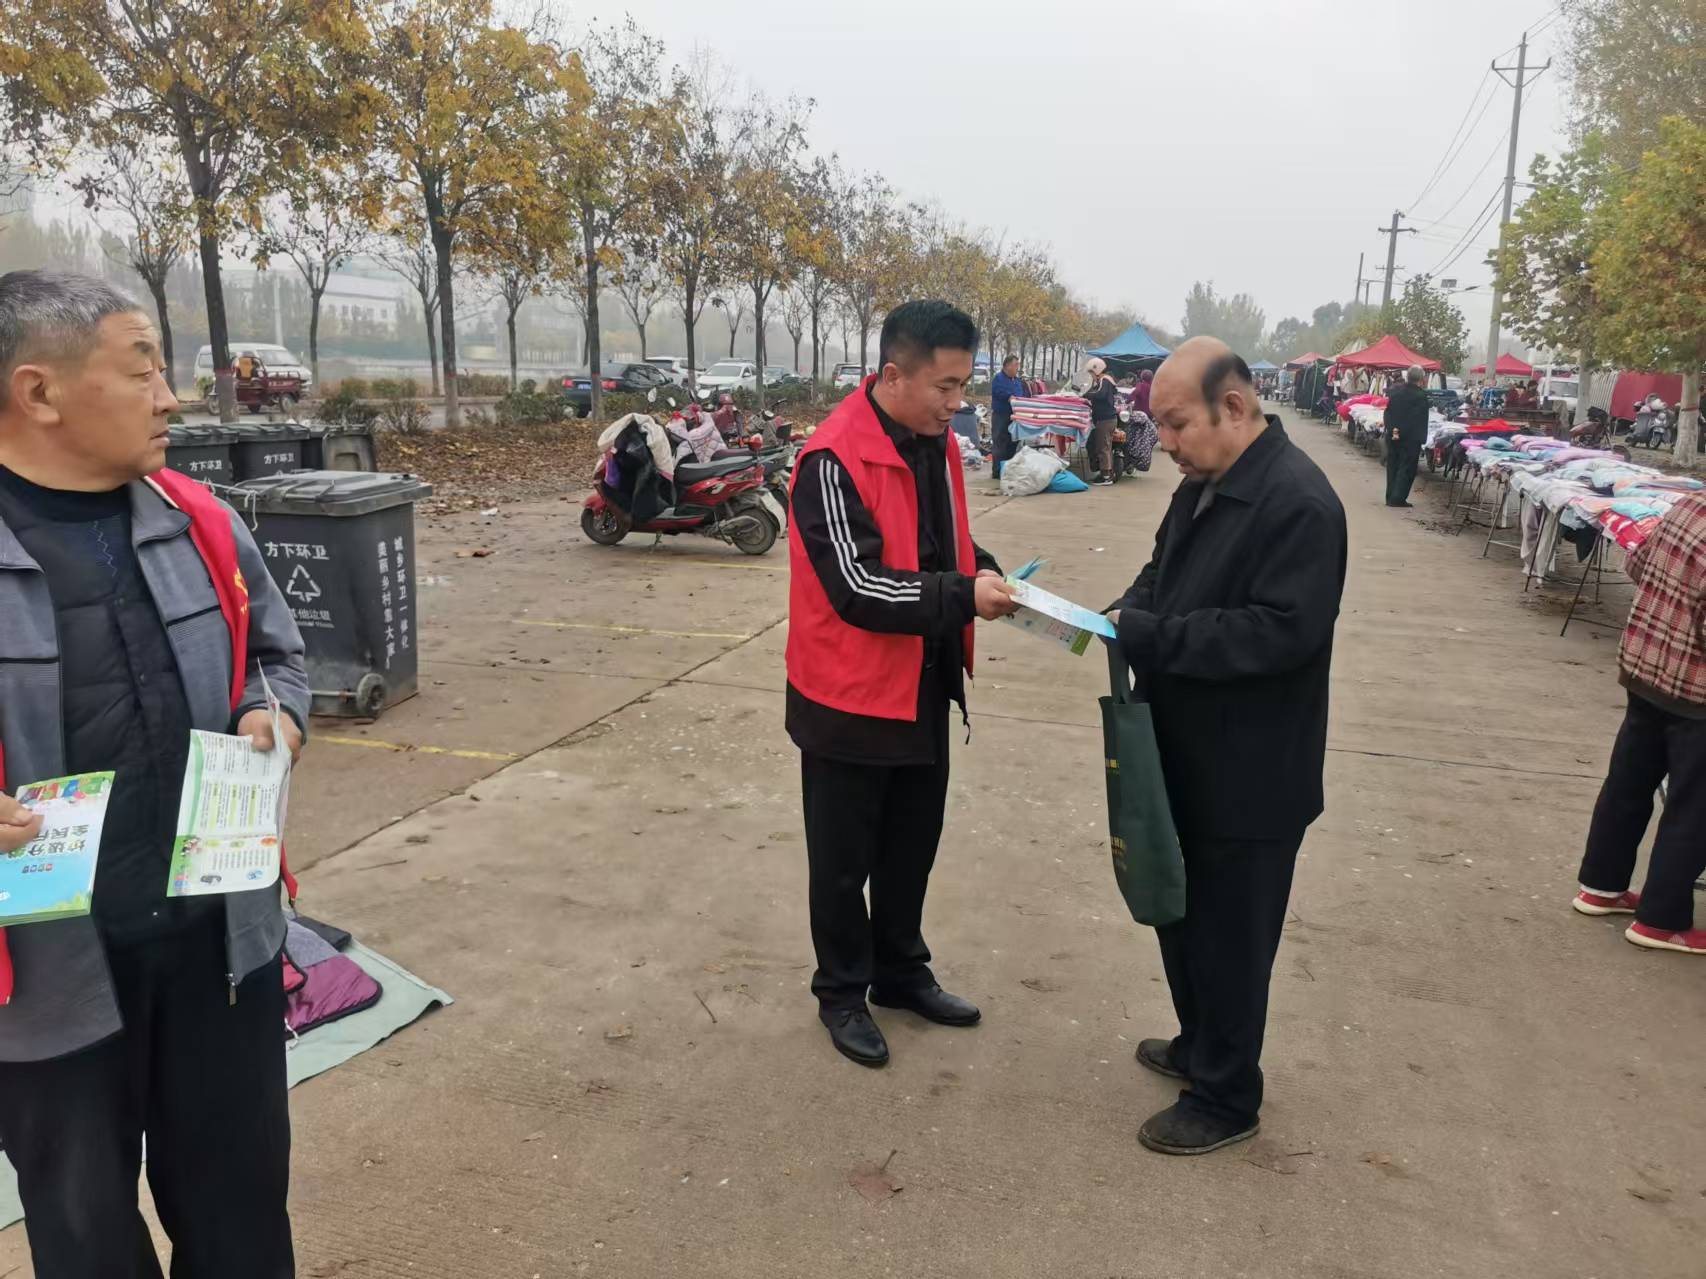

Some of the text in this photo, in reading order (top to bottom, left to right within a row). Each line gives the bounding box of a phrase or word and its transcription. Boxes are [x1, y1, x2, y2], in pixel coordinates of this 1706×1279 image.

[189, 459, 223, 472] 方下环卫
[263, 452, 296, 465] 方下环卫
[265, 541, 330, 560] 方下环卫
[393, 535, 409, 649] 城乡环卫一体化
